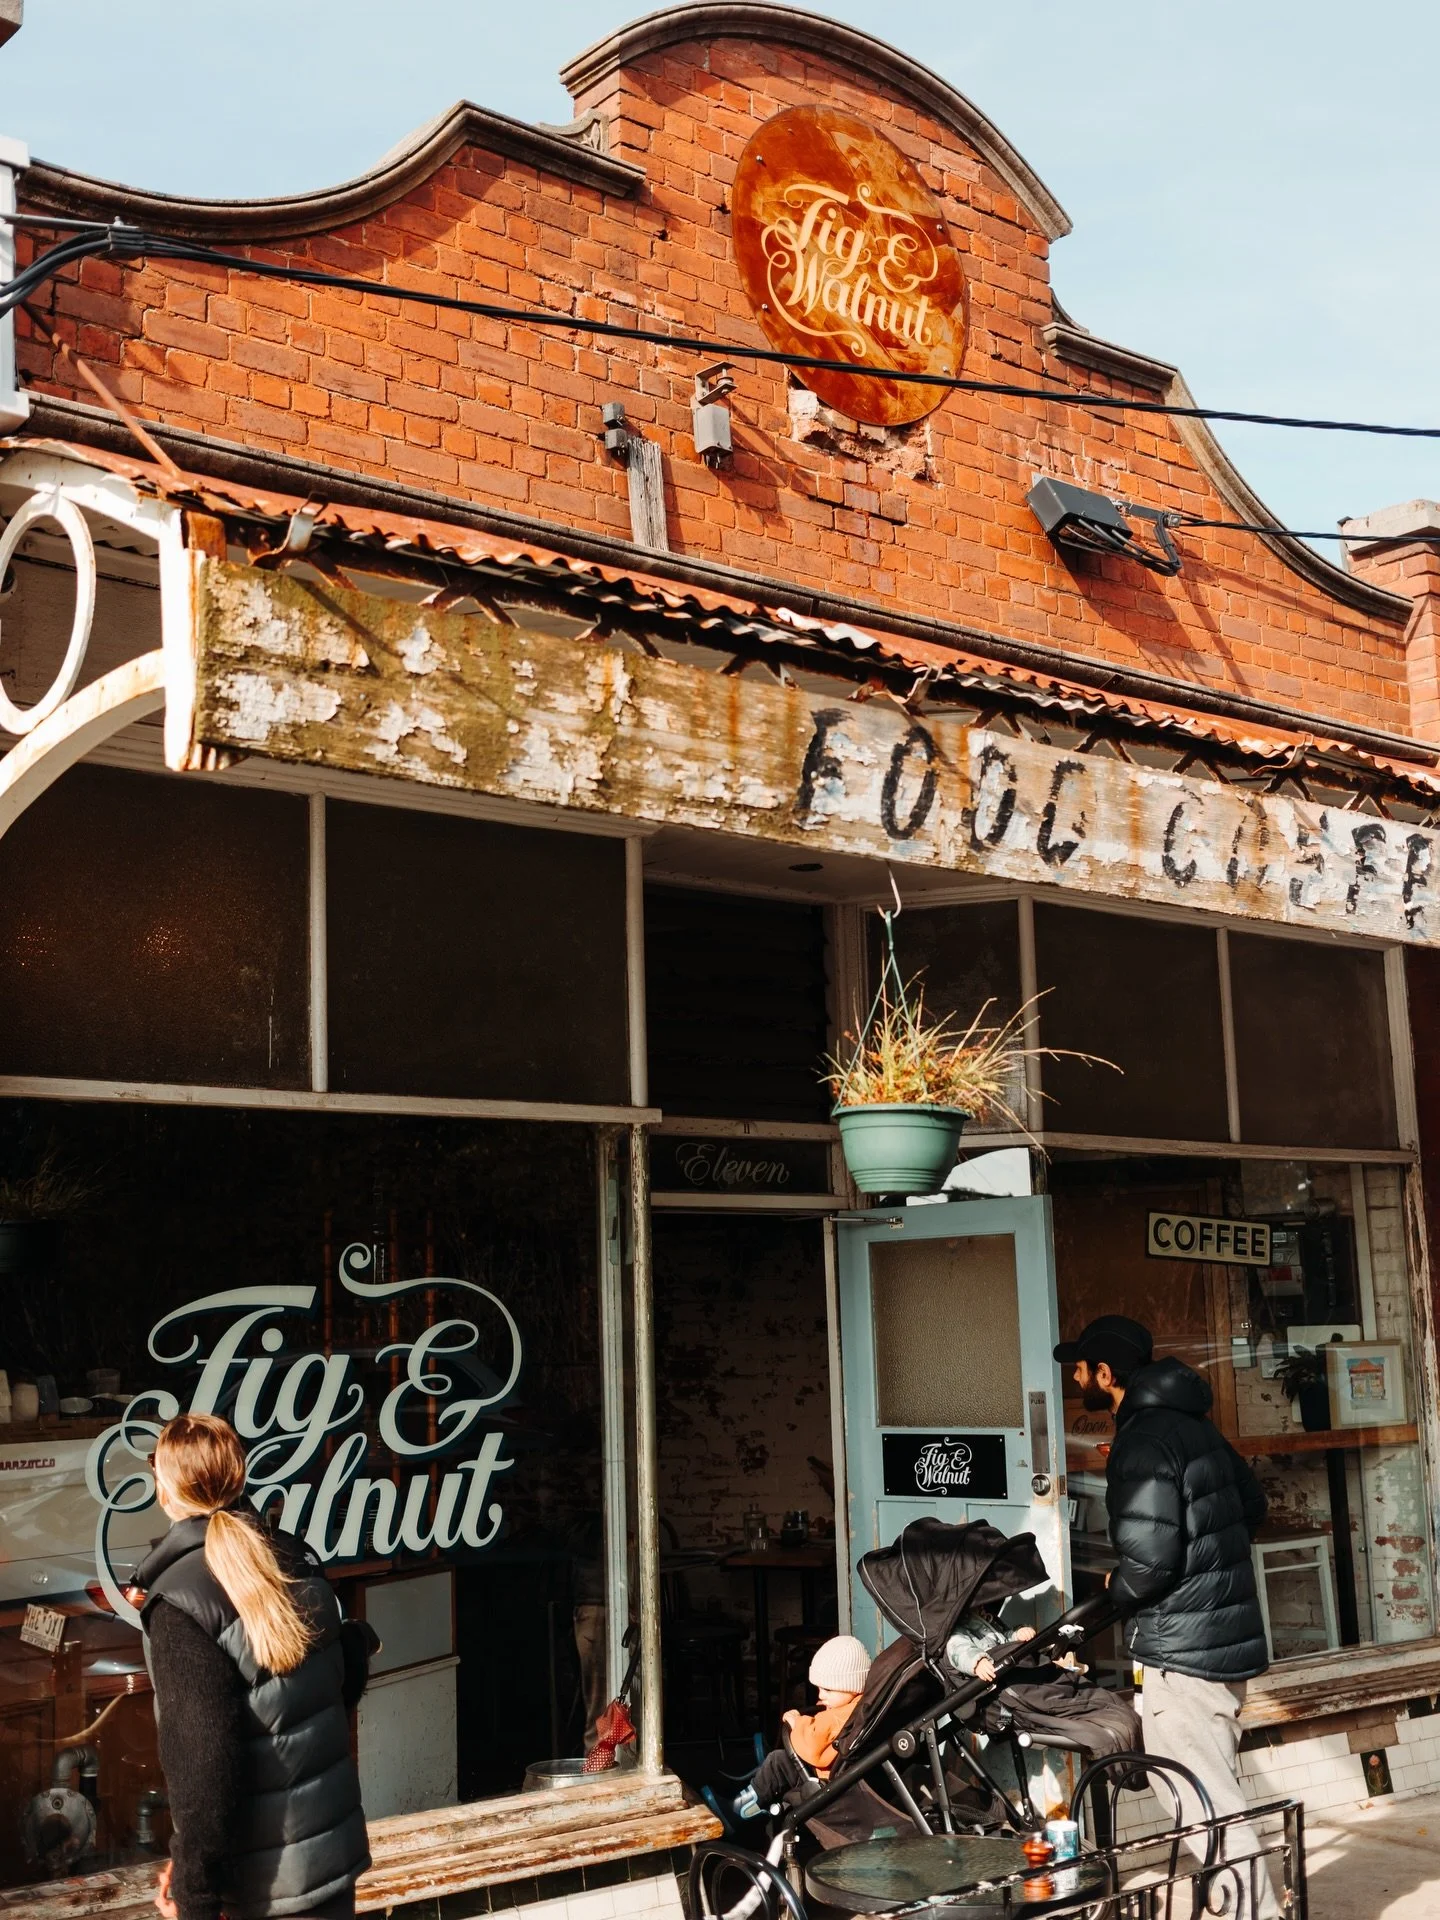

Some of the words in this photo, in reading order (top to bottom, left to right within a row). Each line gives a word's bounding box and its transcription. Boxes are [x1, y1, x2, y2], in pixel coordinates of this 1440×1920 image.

[784, 183, 872, 279] Fig
[761, 216, 936, 358] Walnut
[676, 1142, 790, 1187] Eleven
[1153, 1217, 1266, 1258] COFFEE
[147, 1284, 364, 1485] Fig
[914, 1456, 972, 1495] Walnut
[920, 1443, 949, 1473] Fig
